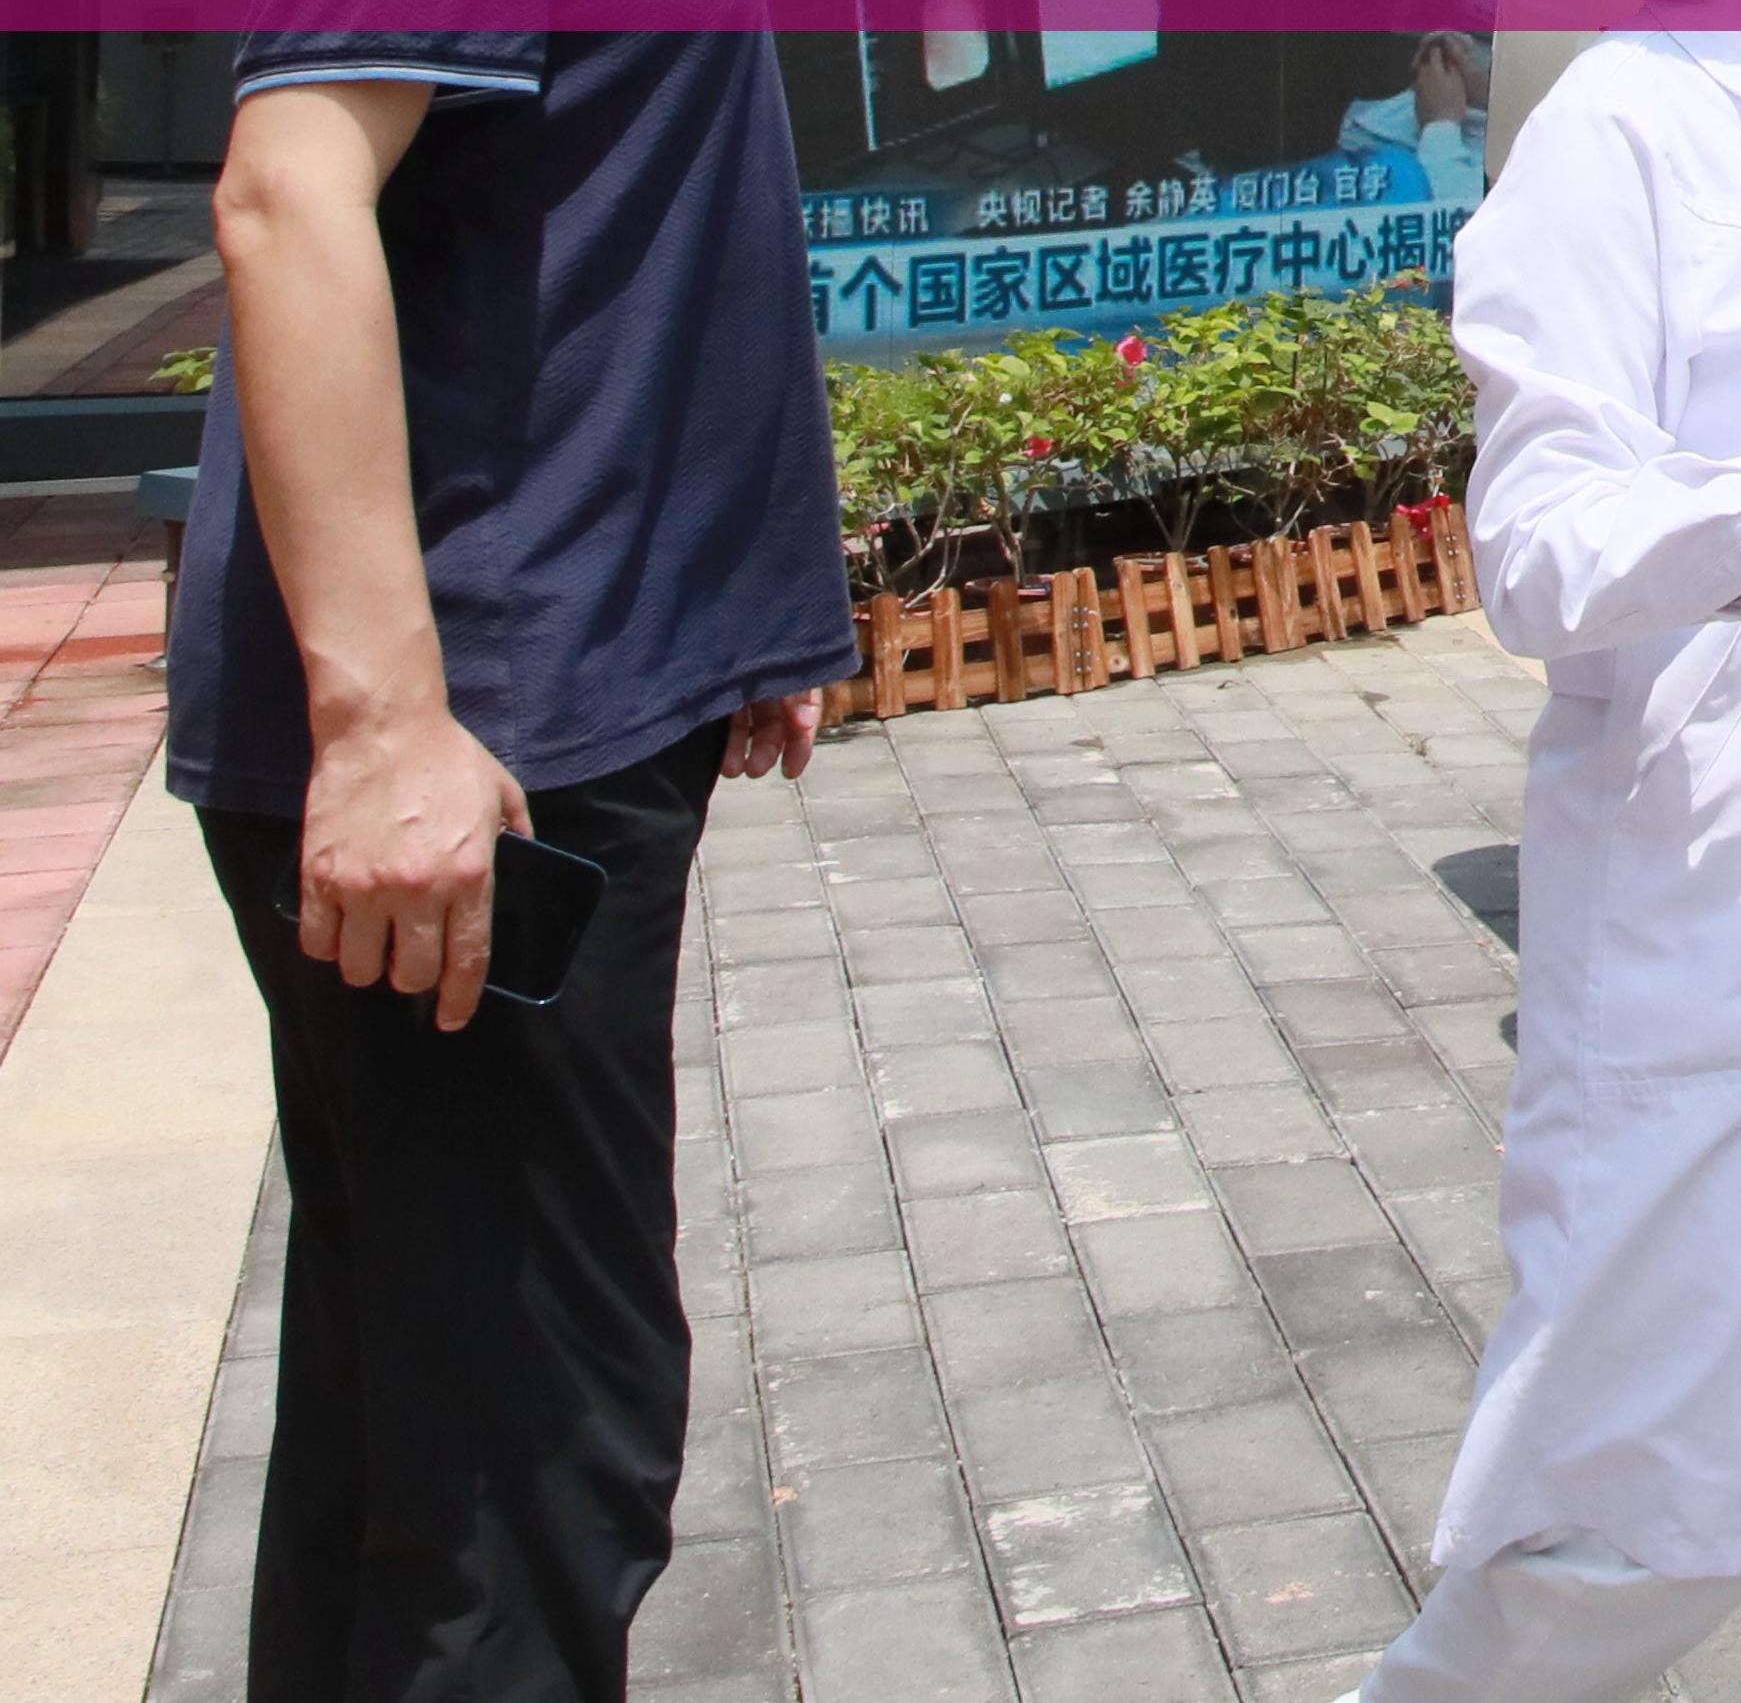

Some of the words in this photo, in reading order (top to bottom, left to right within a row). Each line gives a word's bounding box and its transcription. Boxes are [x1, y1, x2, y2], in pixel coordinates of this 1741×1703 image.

[976, 185, 1109, 228] 央视记者
[1232, 170, 1320, 212] 厦门台
